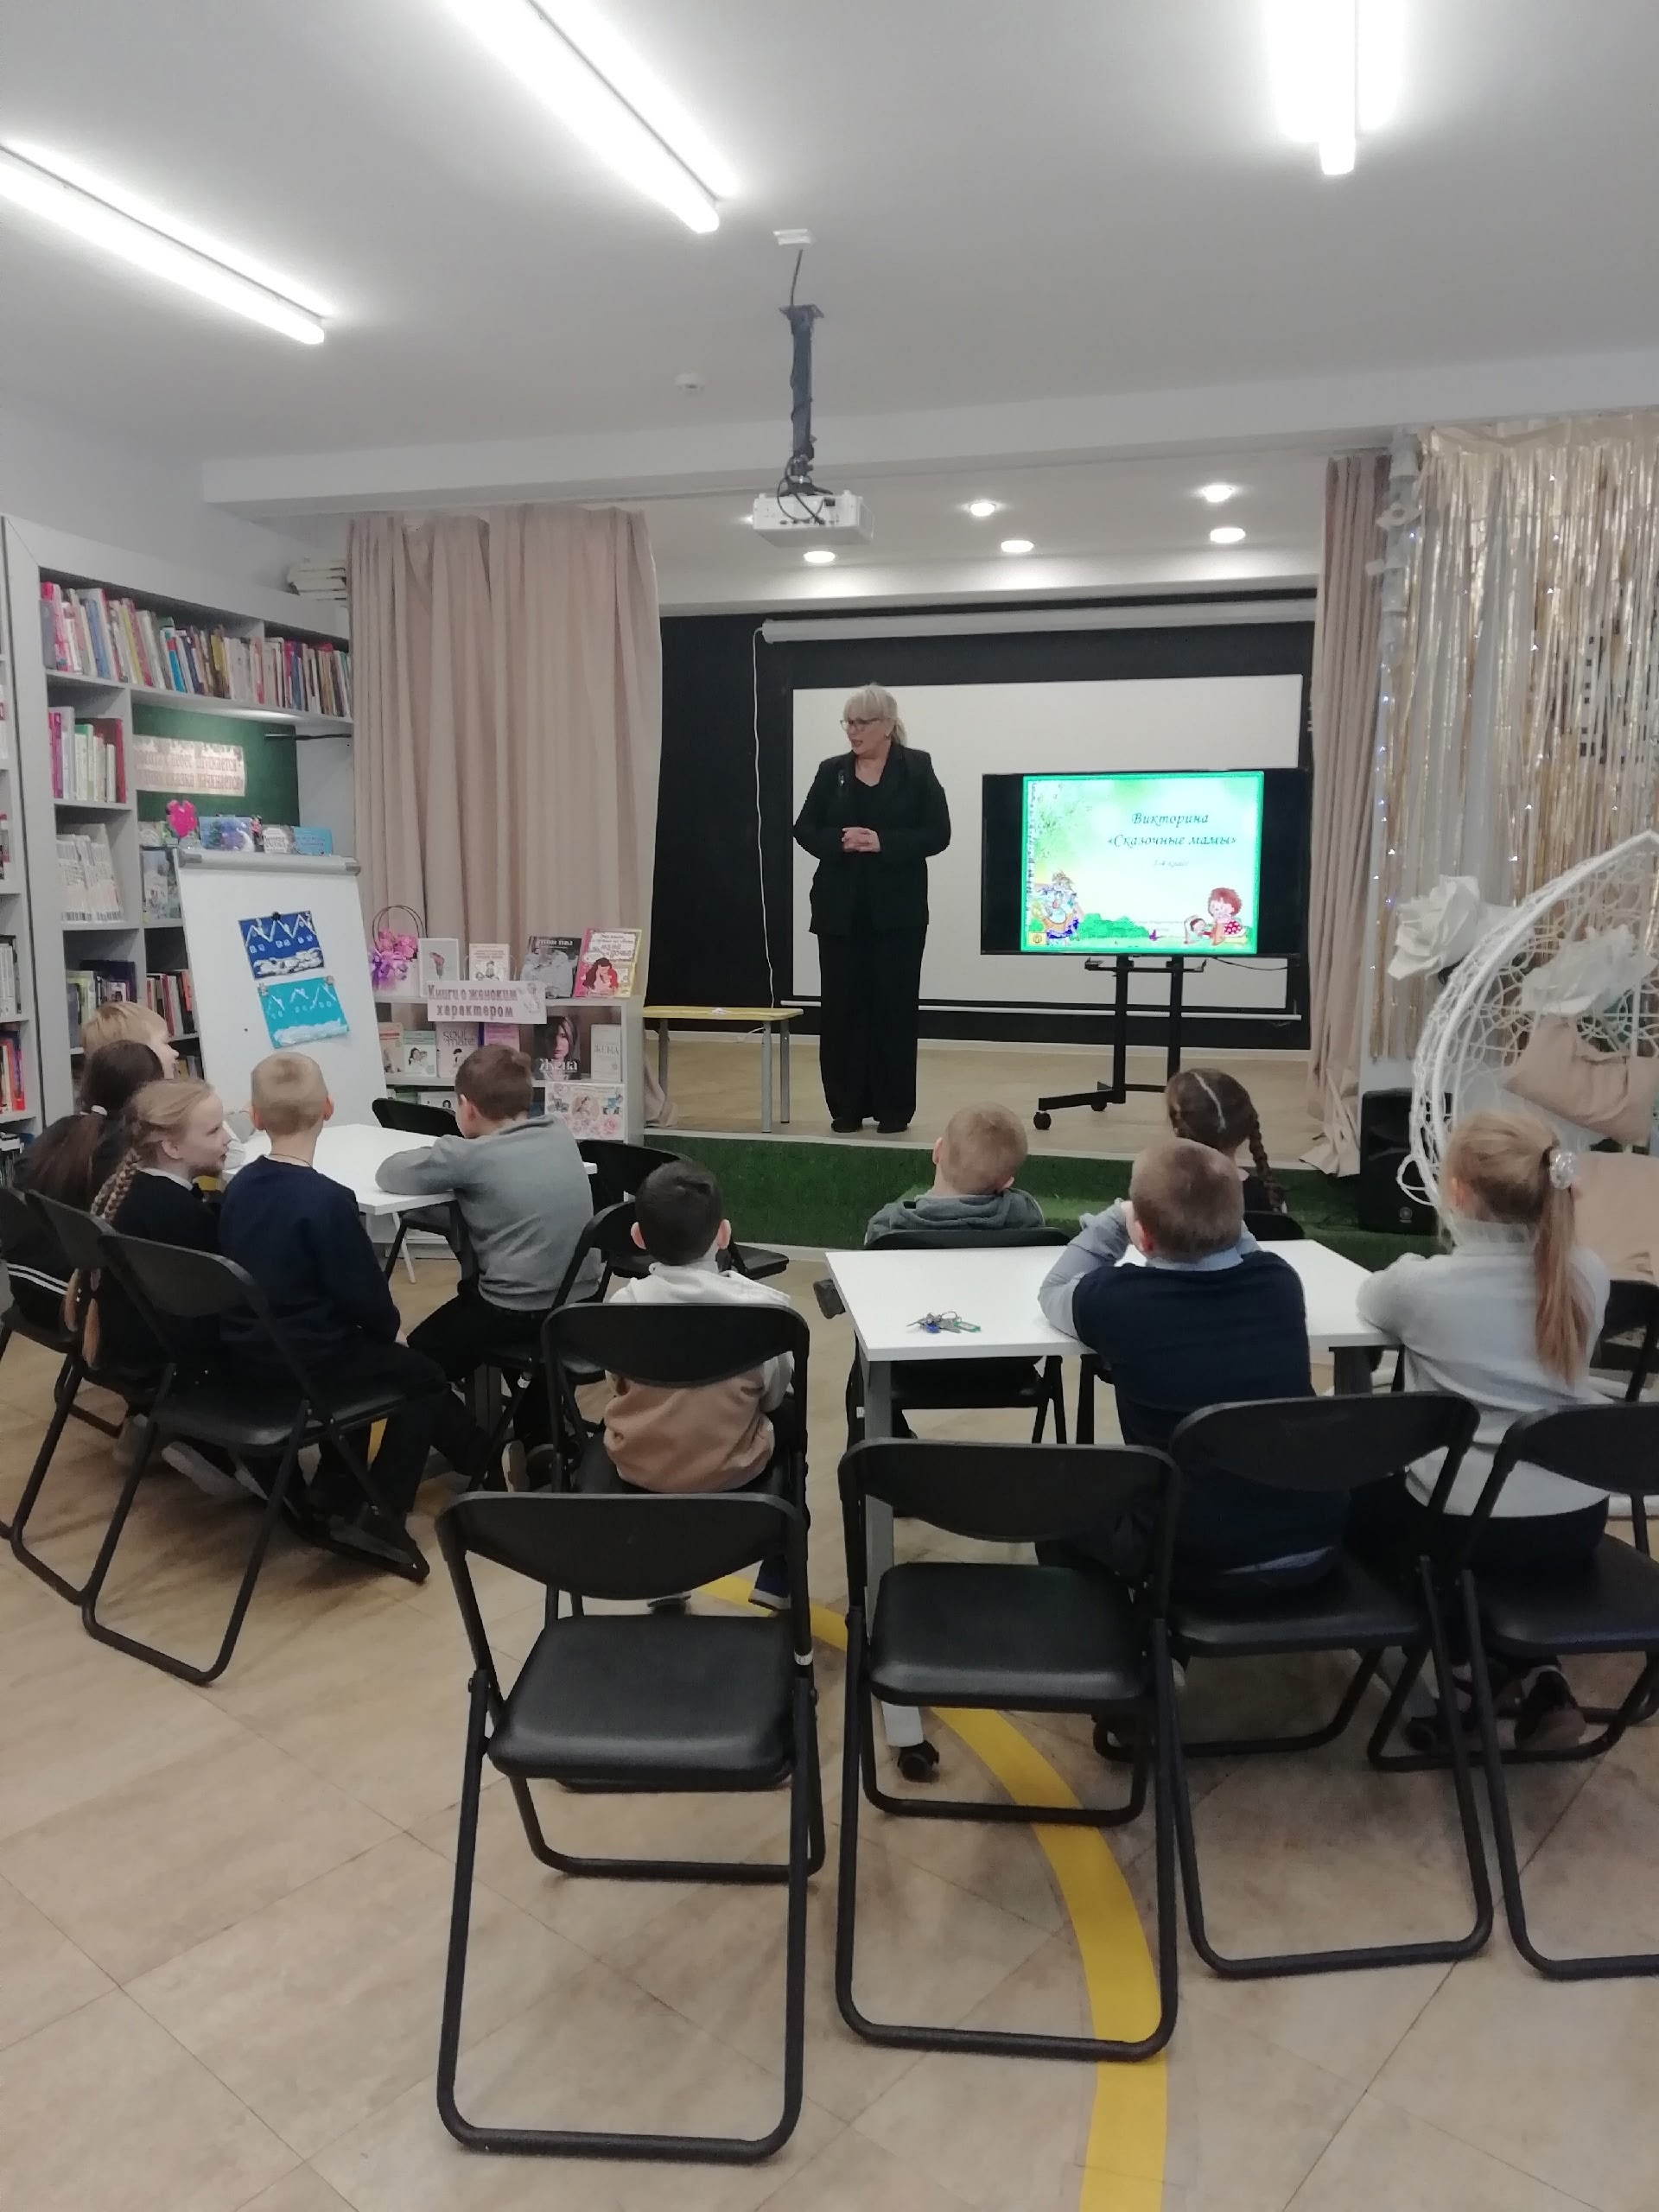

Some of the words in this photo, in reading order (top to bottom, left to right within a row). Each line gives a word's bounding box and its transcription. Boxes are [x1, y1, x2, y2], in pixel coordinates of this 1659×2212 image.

[1132, 812, 1209, 828] Викторина
[1108, 834, 1185, 849] «Сказочные
[1188, 836, 1236, 845] мамы»
[427, 984, 459, 1001] Книги
[468, 988, 518, 1001] женским
[436, 1005, 514, 1020] характером
[594, 1044, 620, 1055] ЖЕНА
[538, 1058, 578, 1071] Жена
